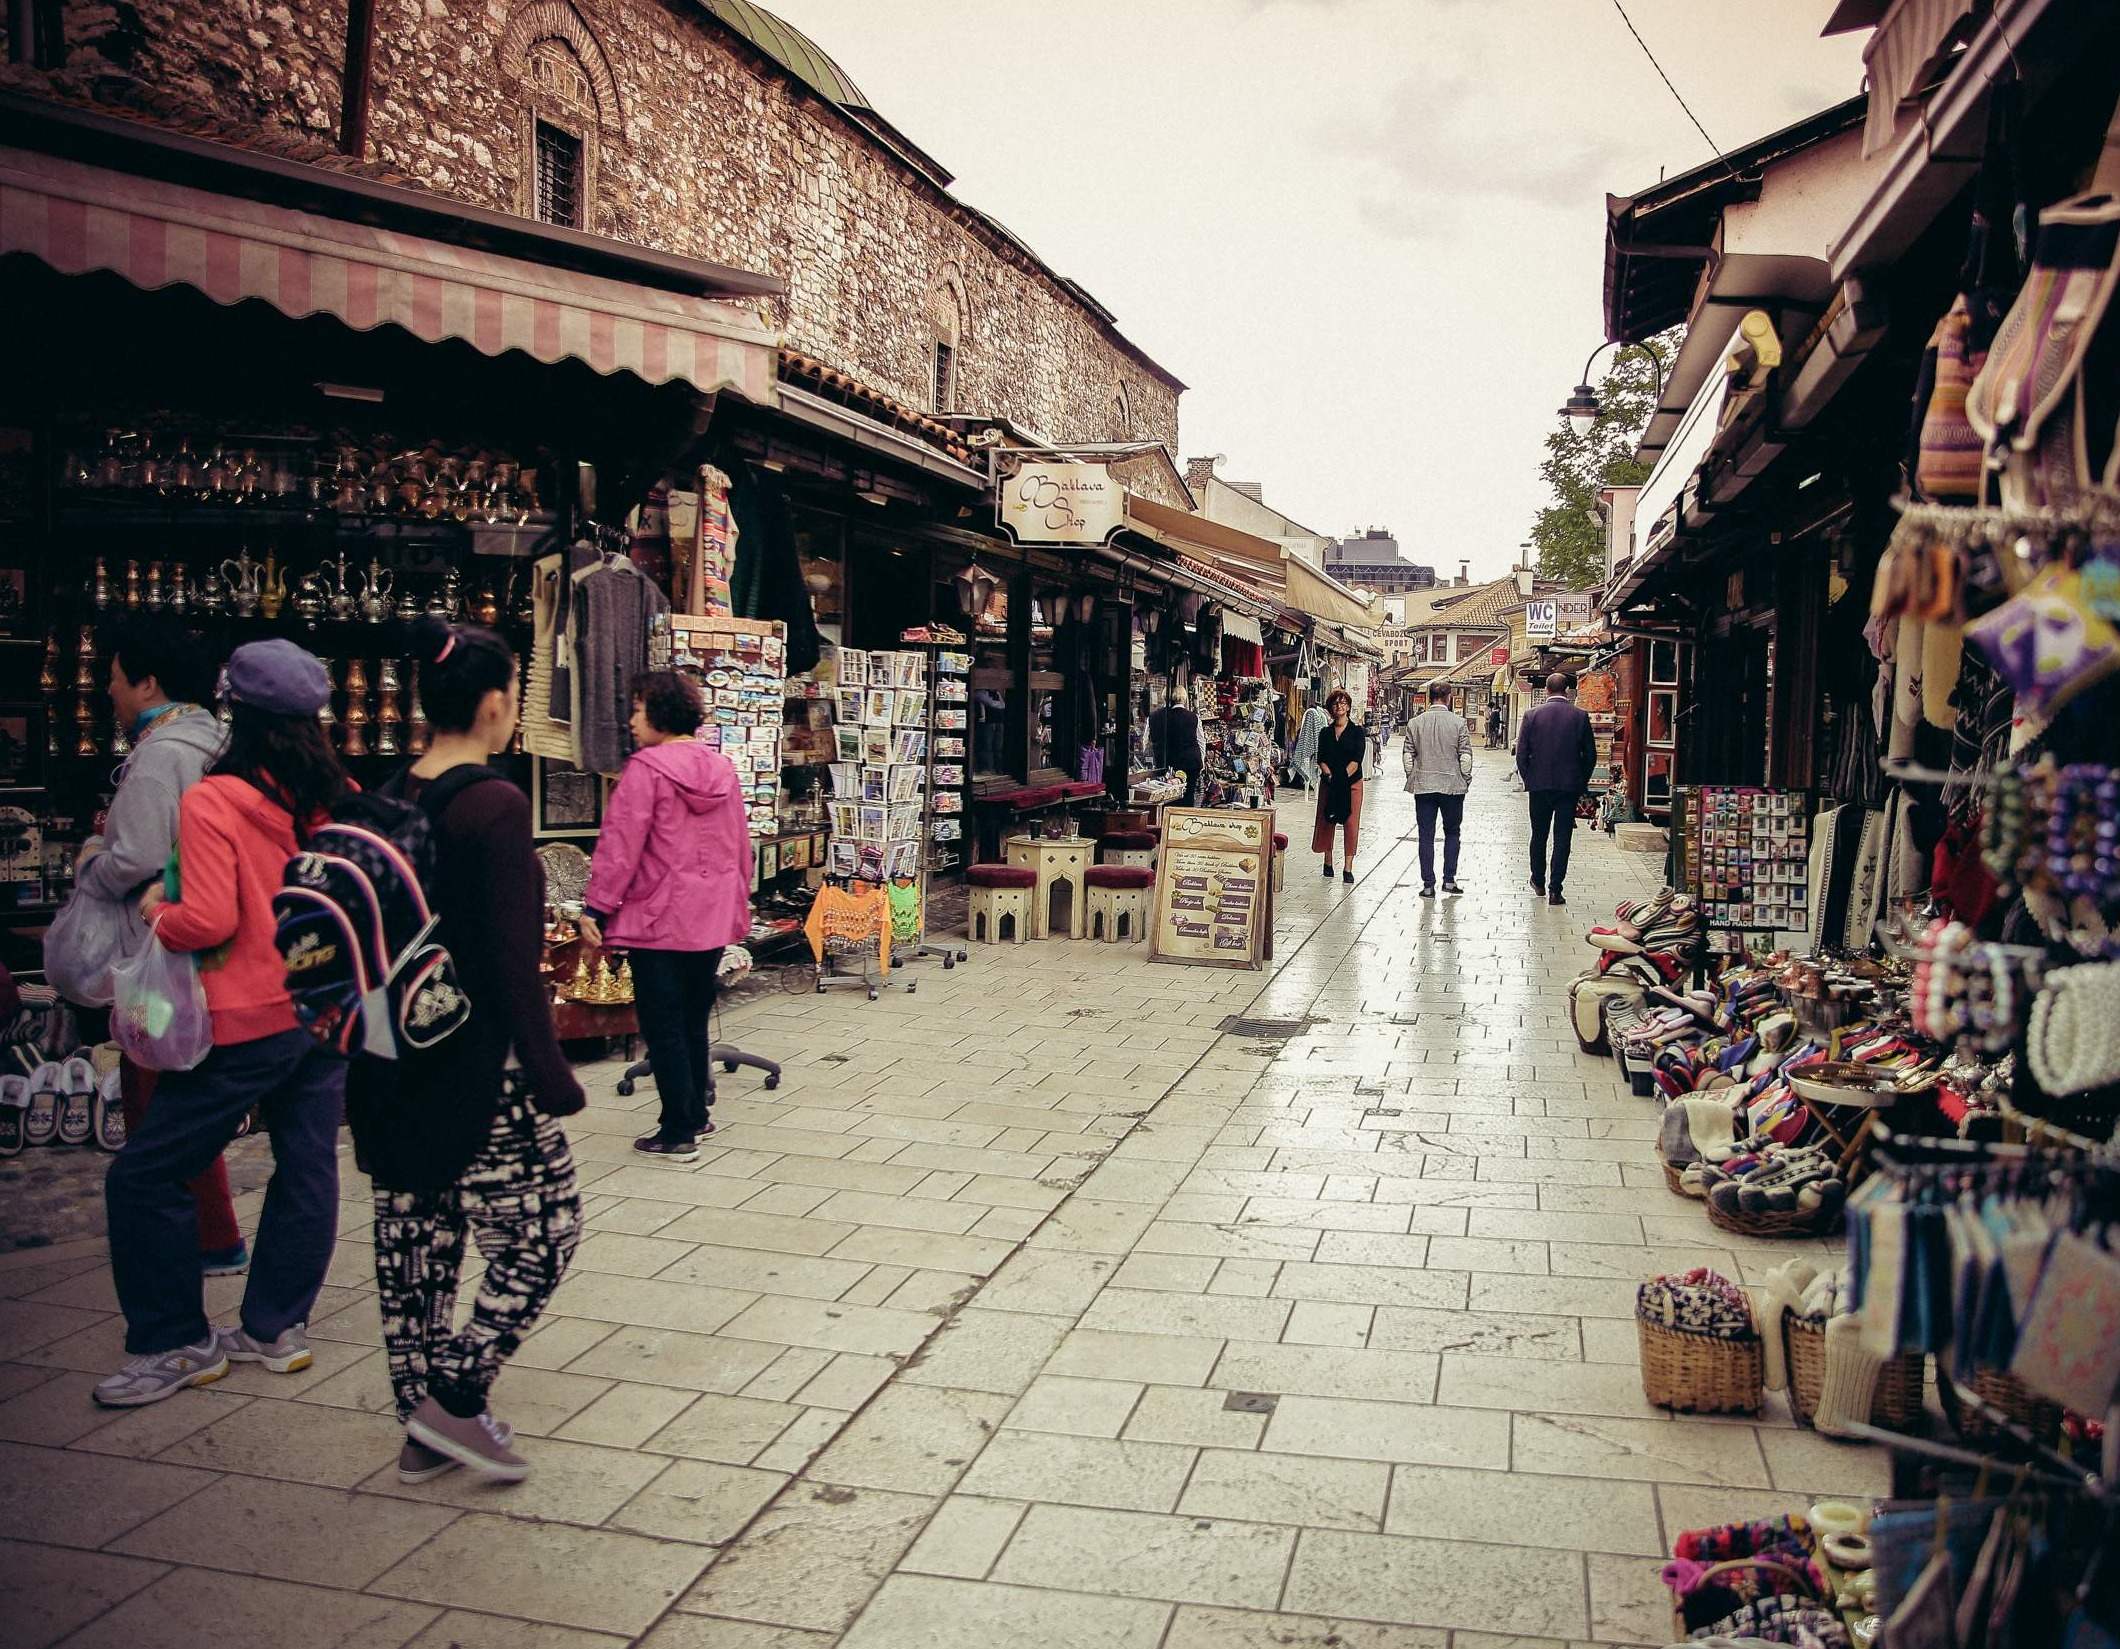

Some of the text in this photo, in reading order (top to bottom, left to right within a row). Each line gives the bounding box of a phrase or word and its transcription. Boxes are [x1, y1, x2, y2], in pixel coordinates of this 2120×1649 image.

[1020, 475, 1105, 508] Baklava
[1528, 603, 1553, 620] WC
[1558, 602, 1588, 614] NDER
[1528, 622, 1554, 630] Toilet
[1384, 639, 1409, 647] SPORT
[1709, 919, 1731, 927] HAND
